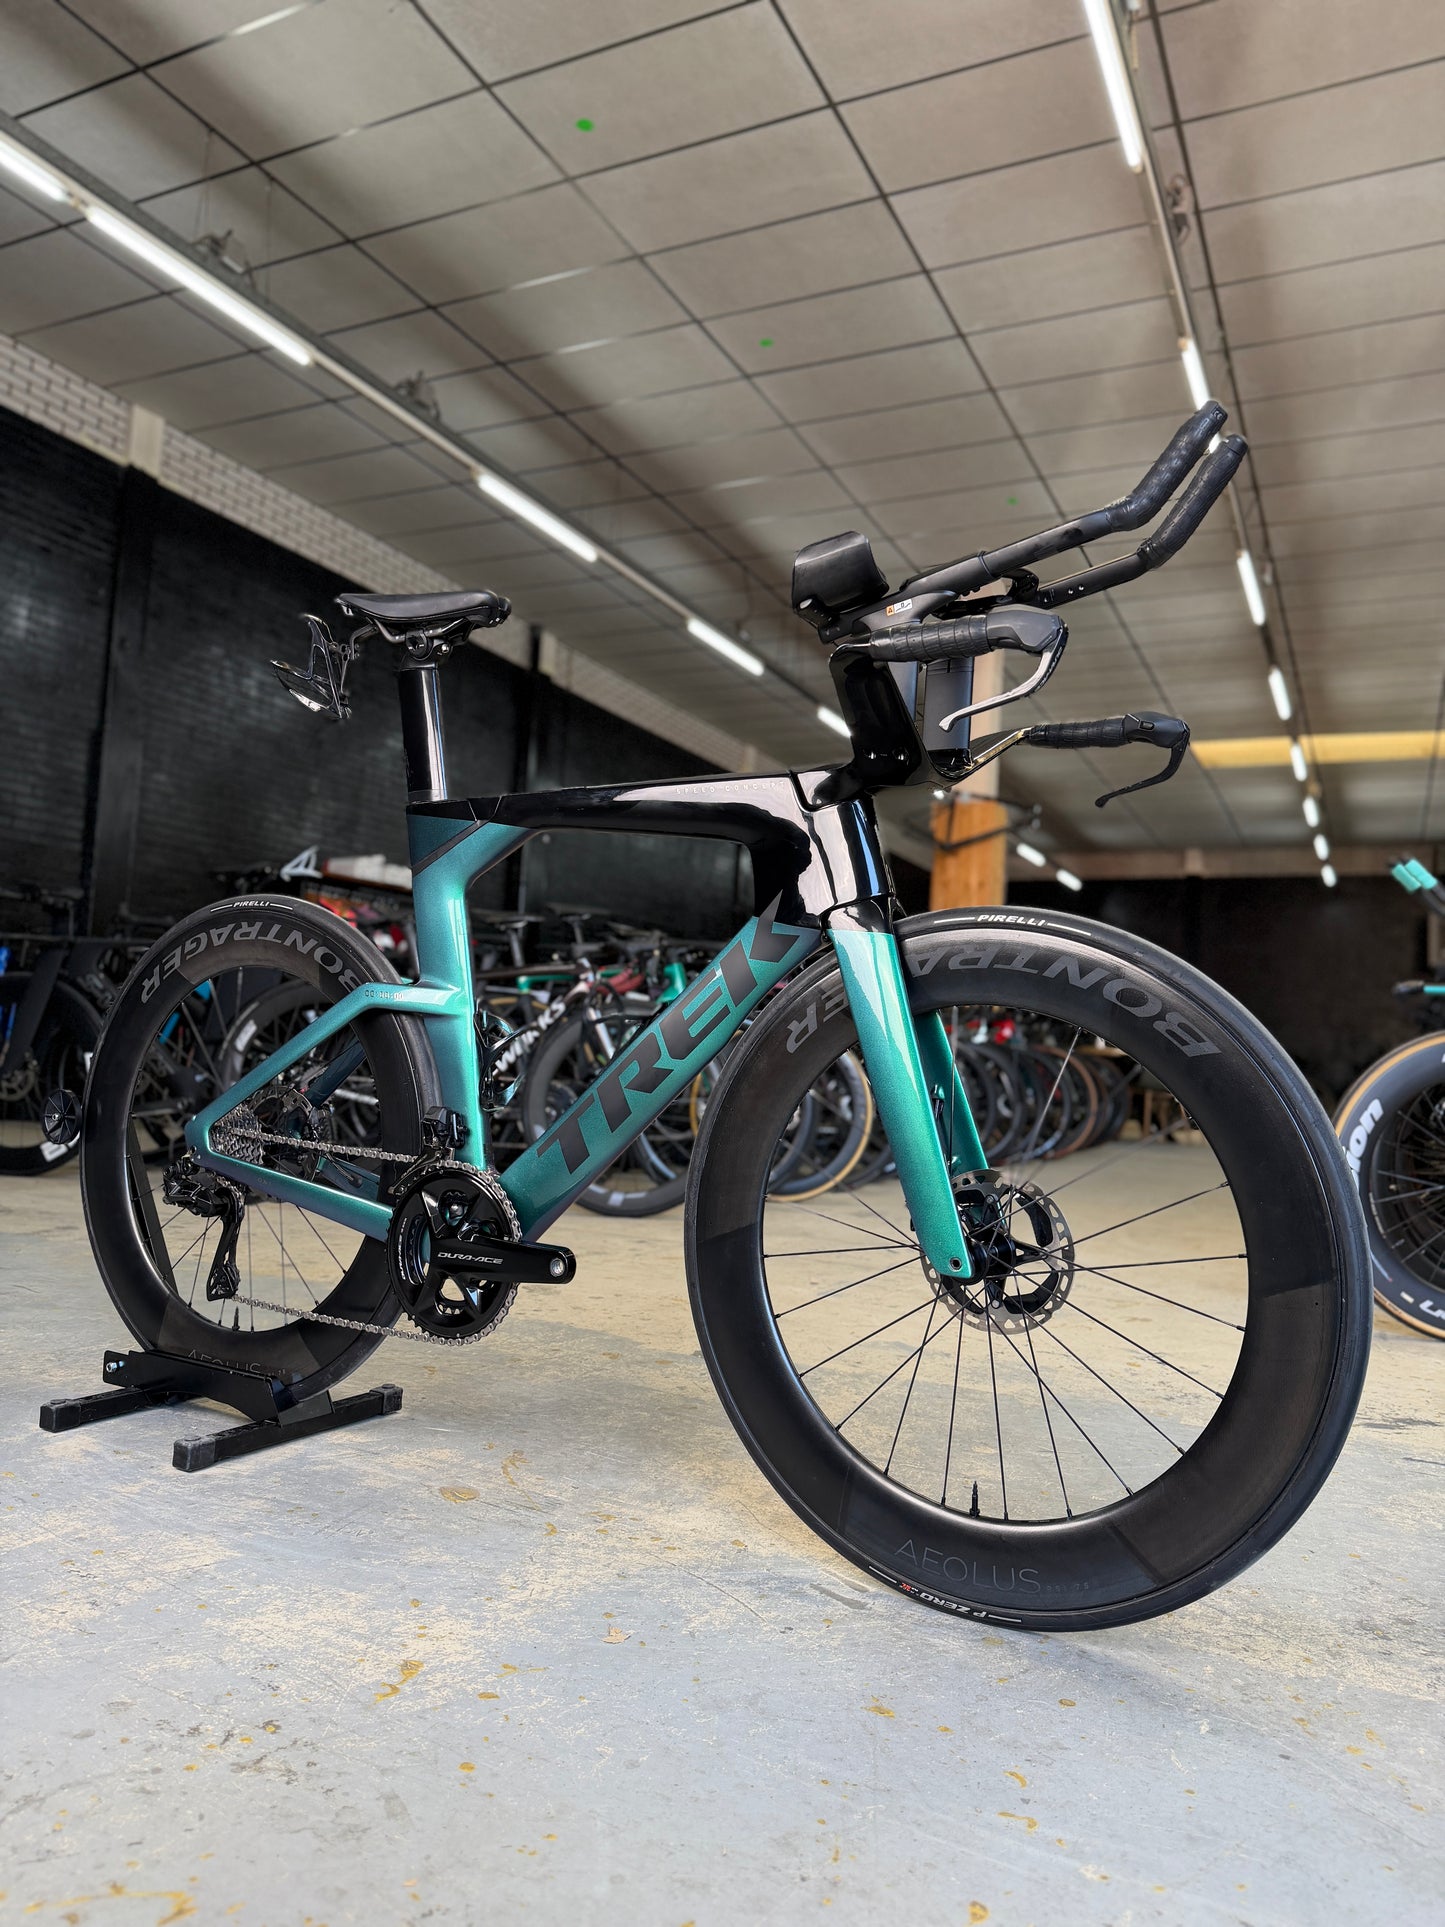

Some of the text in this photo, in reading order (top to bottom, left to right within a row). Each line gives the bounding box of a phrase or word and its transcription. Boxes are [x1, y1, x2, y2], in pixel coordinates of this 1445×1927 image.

[233, 900, 270, 908] PIRELLI
[977, 914, 1046, 927] PIRELLI
[141, 920, 363, 1004] BONTRAGER
[785, 945, 1223, 1058] BONTRAER
[536, 888, 801, 1175] TREK
[437, 1251, 505, 1265] DURA-ACE
[894, 1538, 1042, 1594] AEOLUS
[919, 1591, 971, 1614] ZERO
